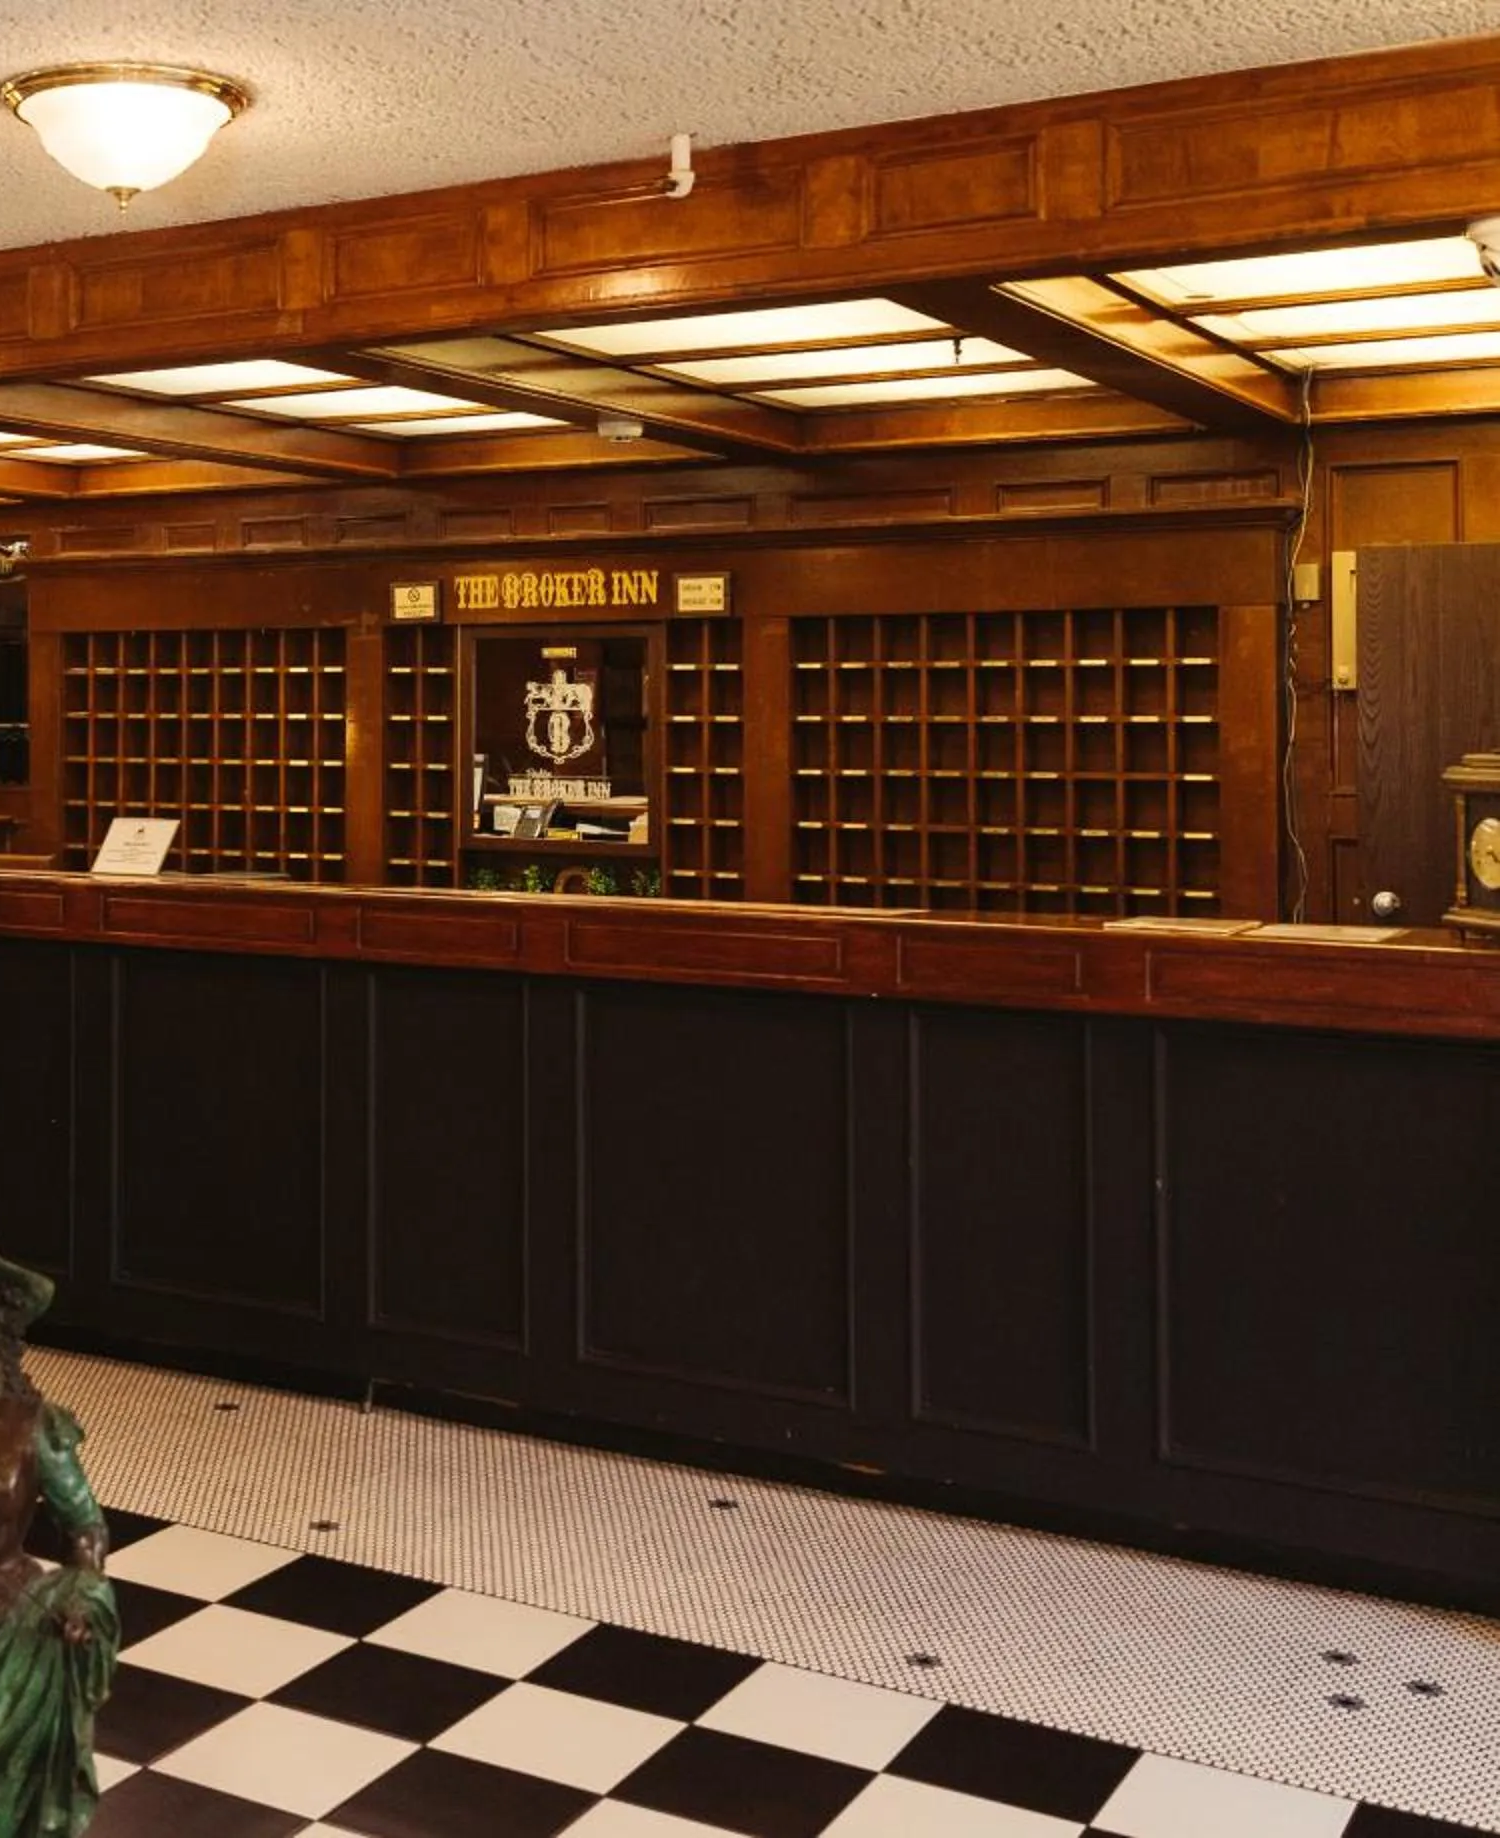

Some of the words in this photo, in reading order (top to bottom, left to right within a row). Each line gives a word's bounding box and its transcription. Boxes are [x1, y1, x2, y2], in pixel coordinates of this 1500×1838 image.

[454, 575, 499, 609] THE
[502, 568, 606, 609] BROKER
[611, 570, 659, 605] INN
